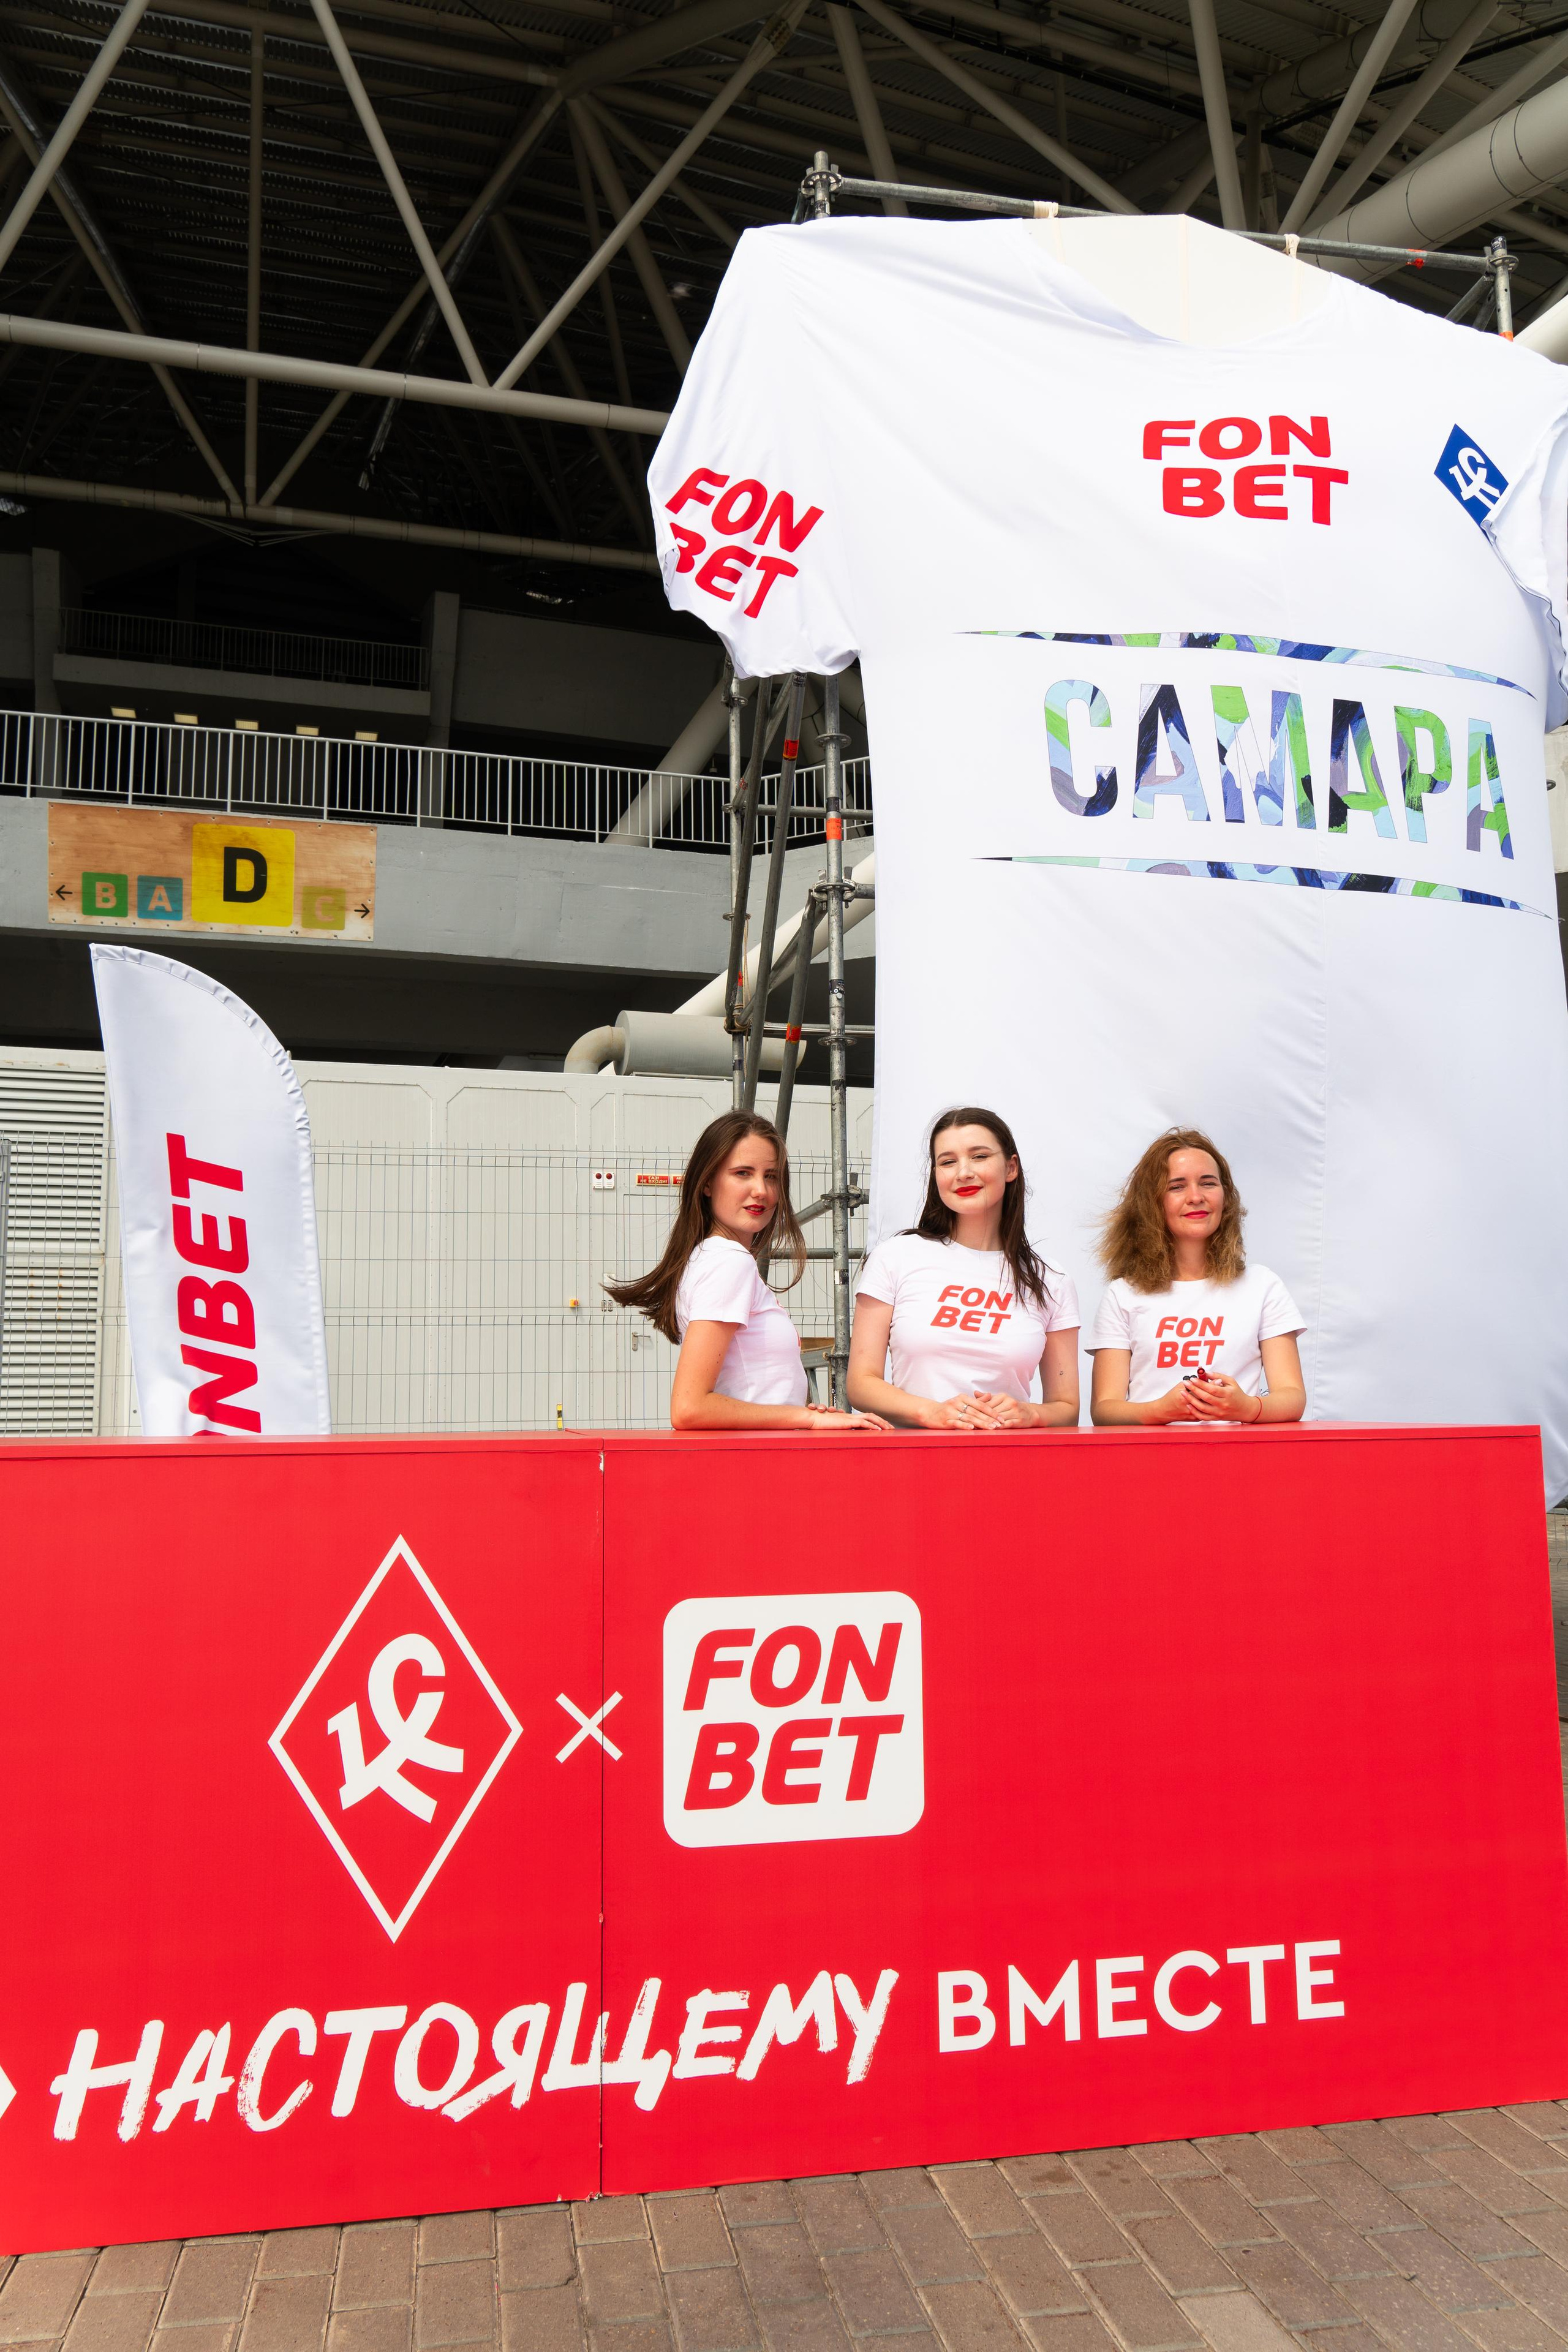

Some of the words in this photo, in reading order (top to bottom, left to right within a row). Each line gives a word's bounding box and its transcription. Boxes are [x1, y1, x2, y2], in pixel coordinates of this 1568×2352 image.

[1142, 415, 1332, 461] FON
[665, 467, 824, 552] FON
[1162, 464, 1349, 526] BET
[669, 522, 799, 619] BET
[1044, 679, 1515, 860] САМАРА
[94, 881, 117, 909] B
[148, 884, 173, 912] A
[222, 846, 268, 903] D
[314, 895, 335, 922] C
[167, 1133, 262, 1436] NBET
[930, 1305, 1012, 1334] BET
[937, 1285, 1013, 1311] FON
[1155, 1316, 1224, 1338] FON
[1156, 1340, 1225, 1368] BET
[683, 1622, 903, 1711] FON
[683, 1714, 905, 1811] BET
[50, 1969, 899, 2143] НАСТОЯЩЕМУ
[938, 1939, 1345, 2052] ВМЕСТЕ
